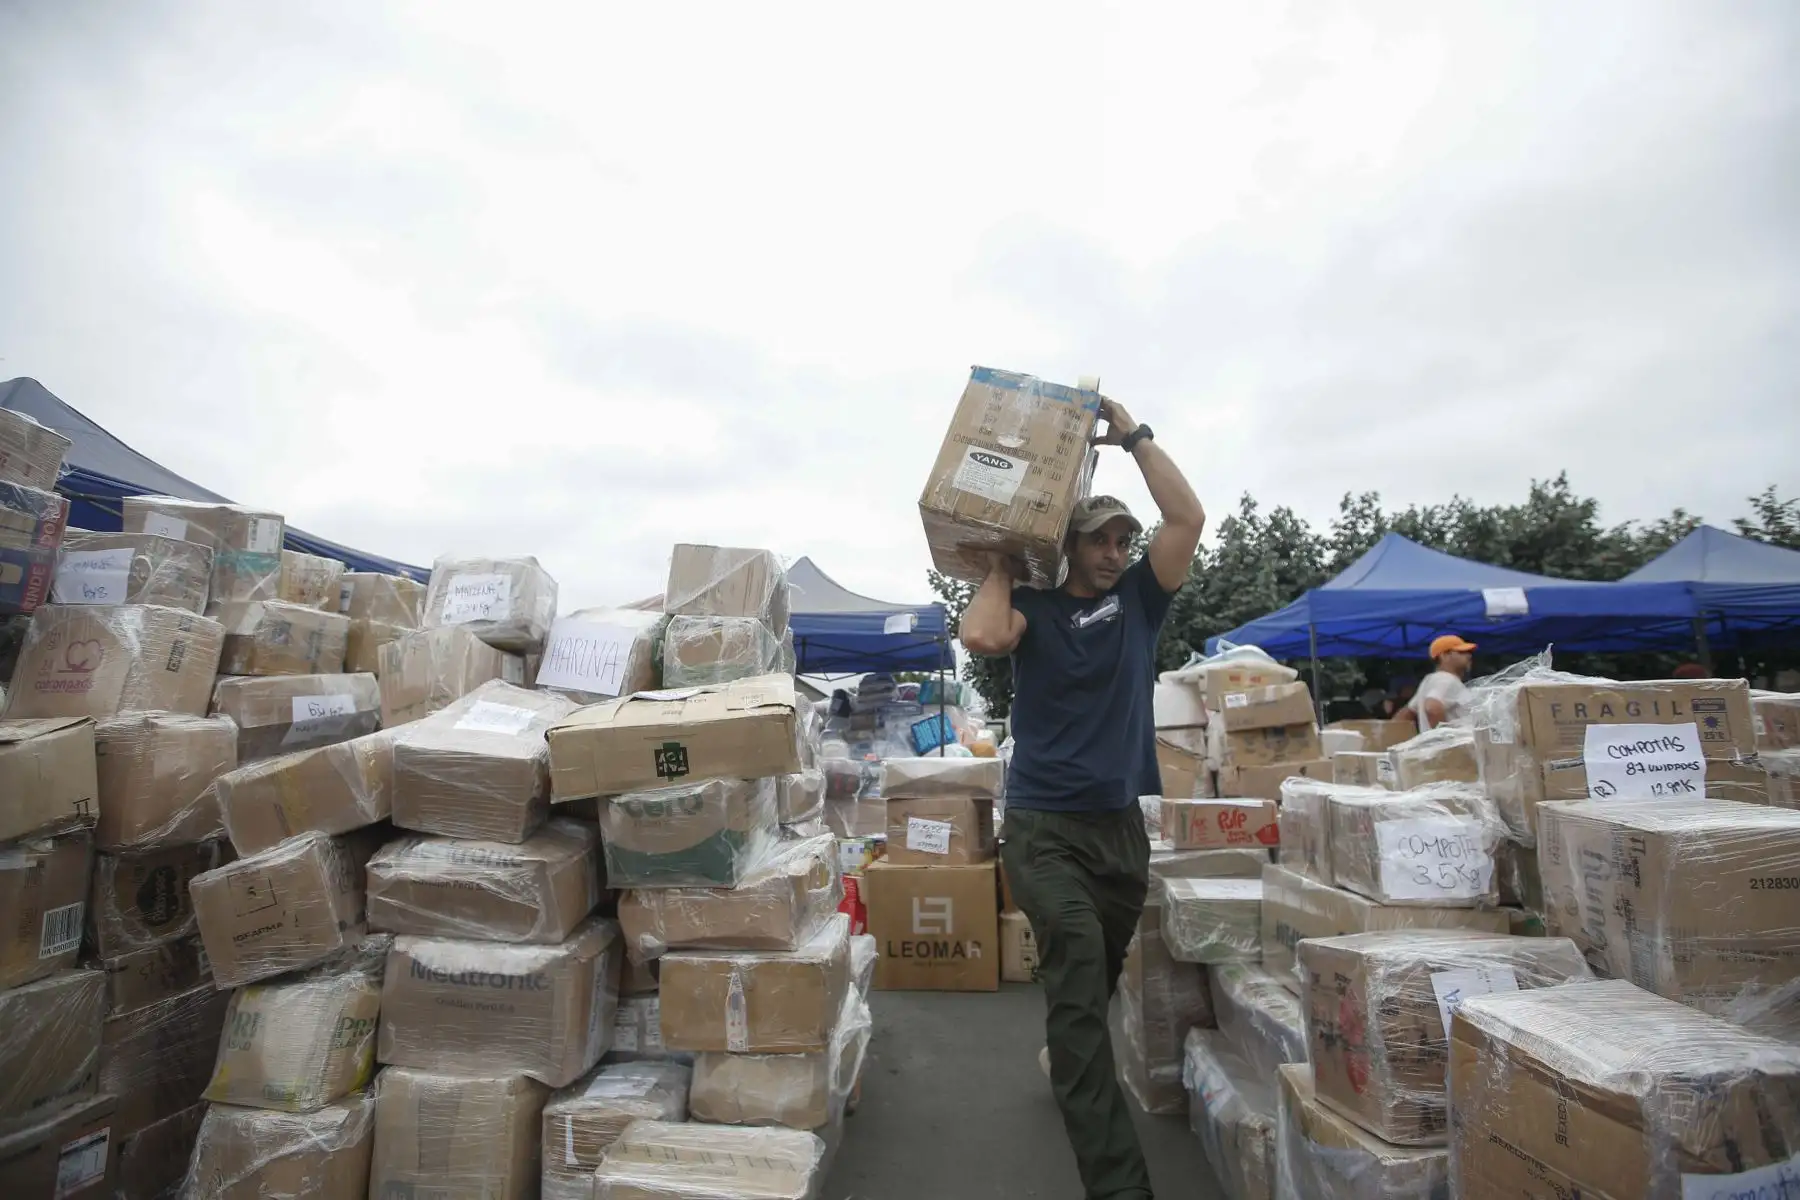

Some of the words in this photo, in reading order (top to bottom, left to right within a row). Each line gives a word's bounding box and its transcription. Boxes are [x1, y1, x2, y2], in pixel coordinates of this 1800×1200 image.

[974, 453, 1010, 470] YANG
[548, 634, 622, 686] HARINA
[1551, 700, 1685, 718] FRAGIL
[1607, 736, 1686, 759] COMPOTAS
[1625, 761, 1646, 776] 87
[1749, 877, 1800, 890] 212830
